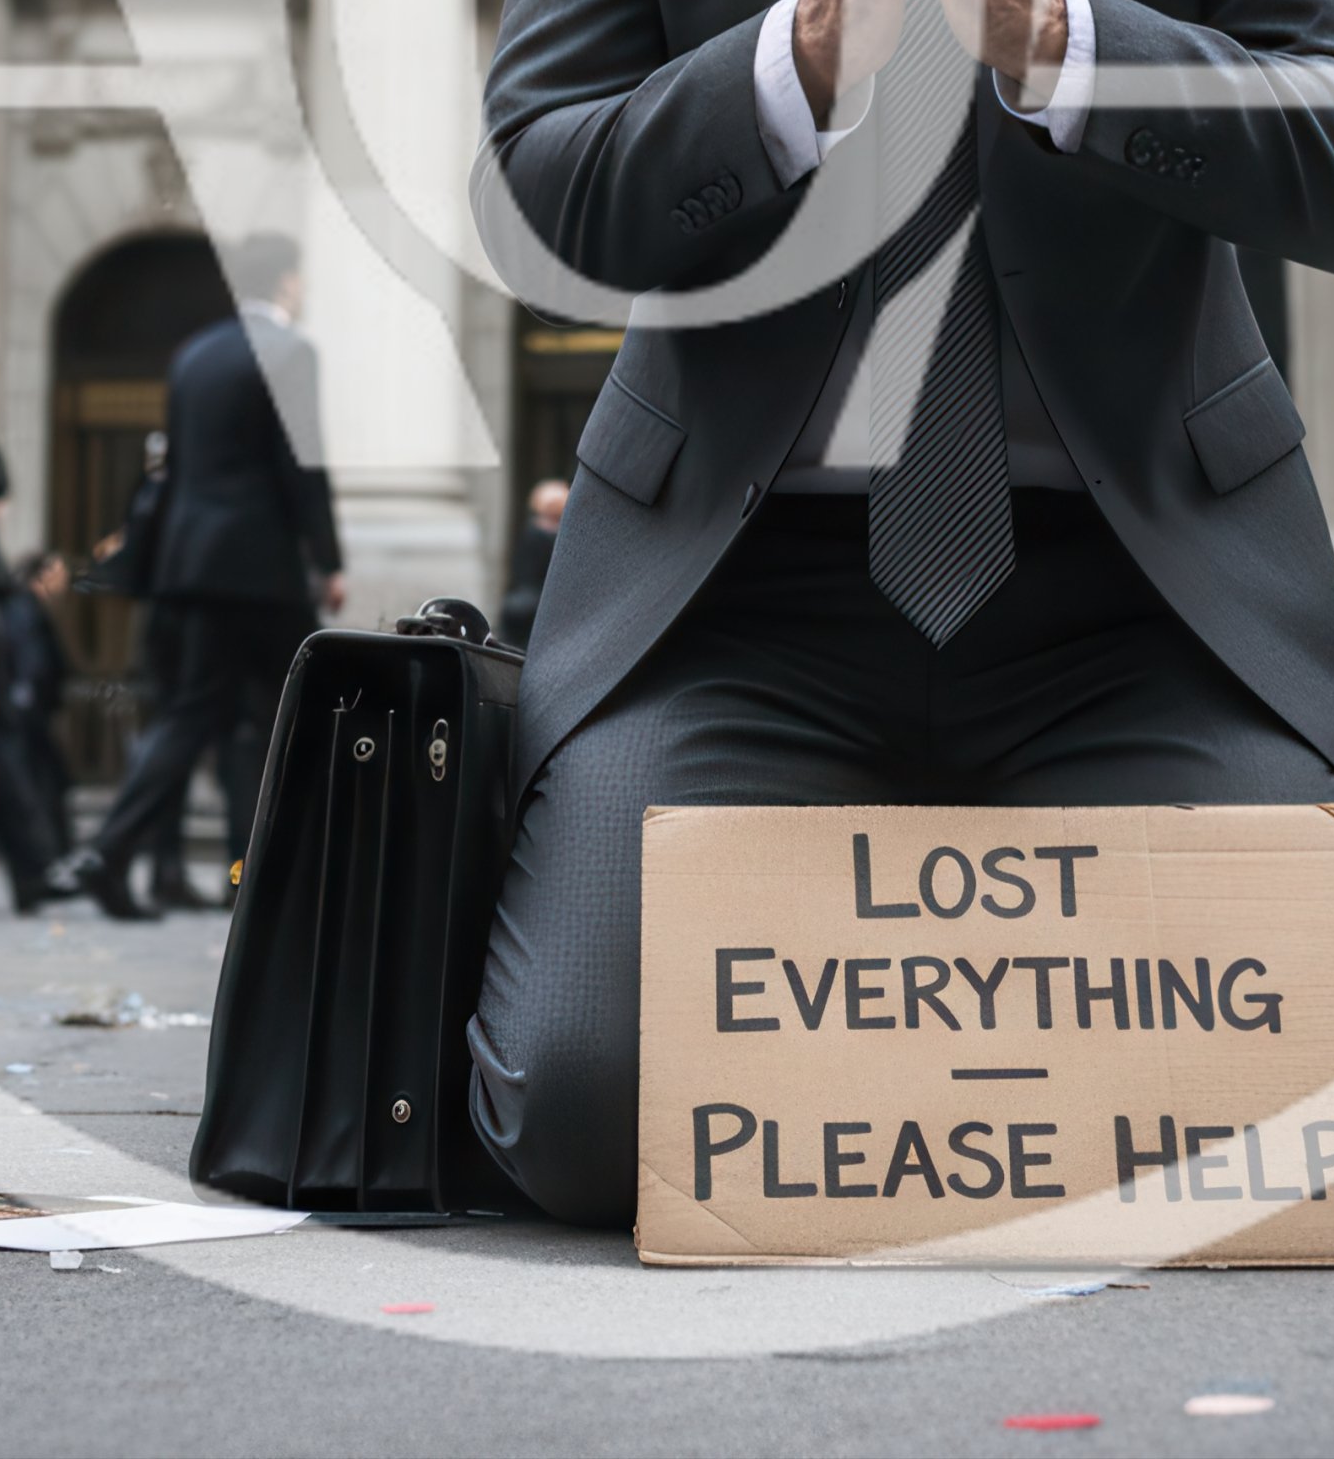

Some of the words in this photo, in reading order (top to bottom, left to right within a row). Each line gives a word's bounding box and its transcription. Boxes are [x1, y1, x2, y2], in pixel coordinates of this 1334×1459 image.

[852, 832, 1099, 920] LOST
[714, 946, 1284, 1035] EVERYTHING
[691, 1102, 1067, 1202] PLEASE
